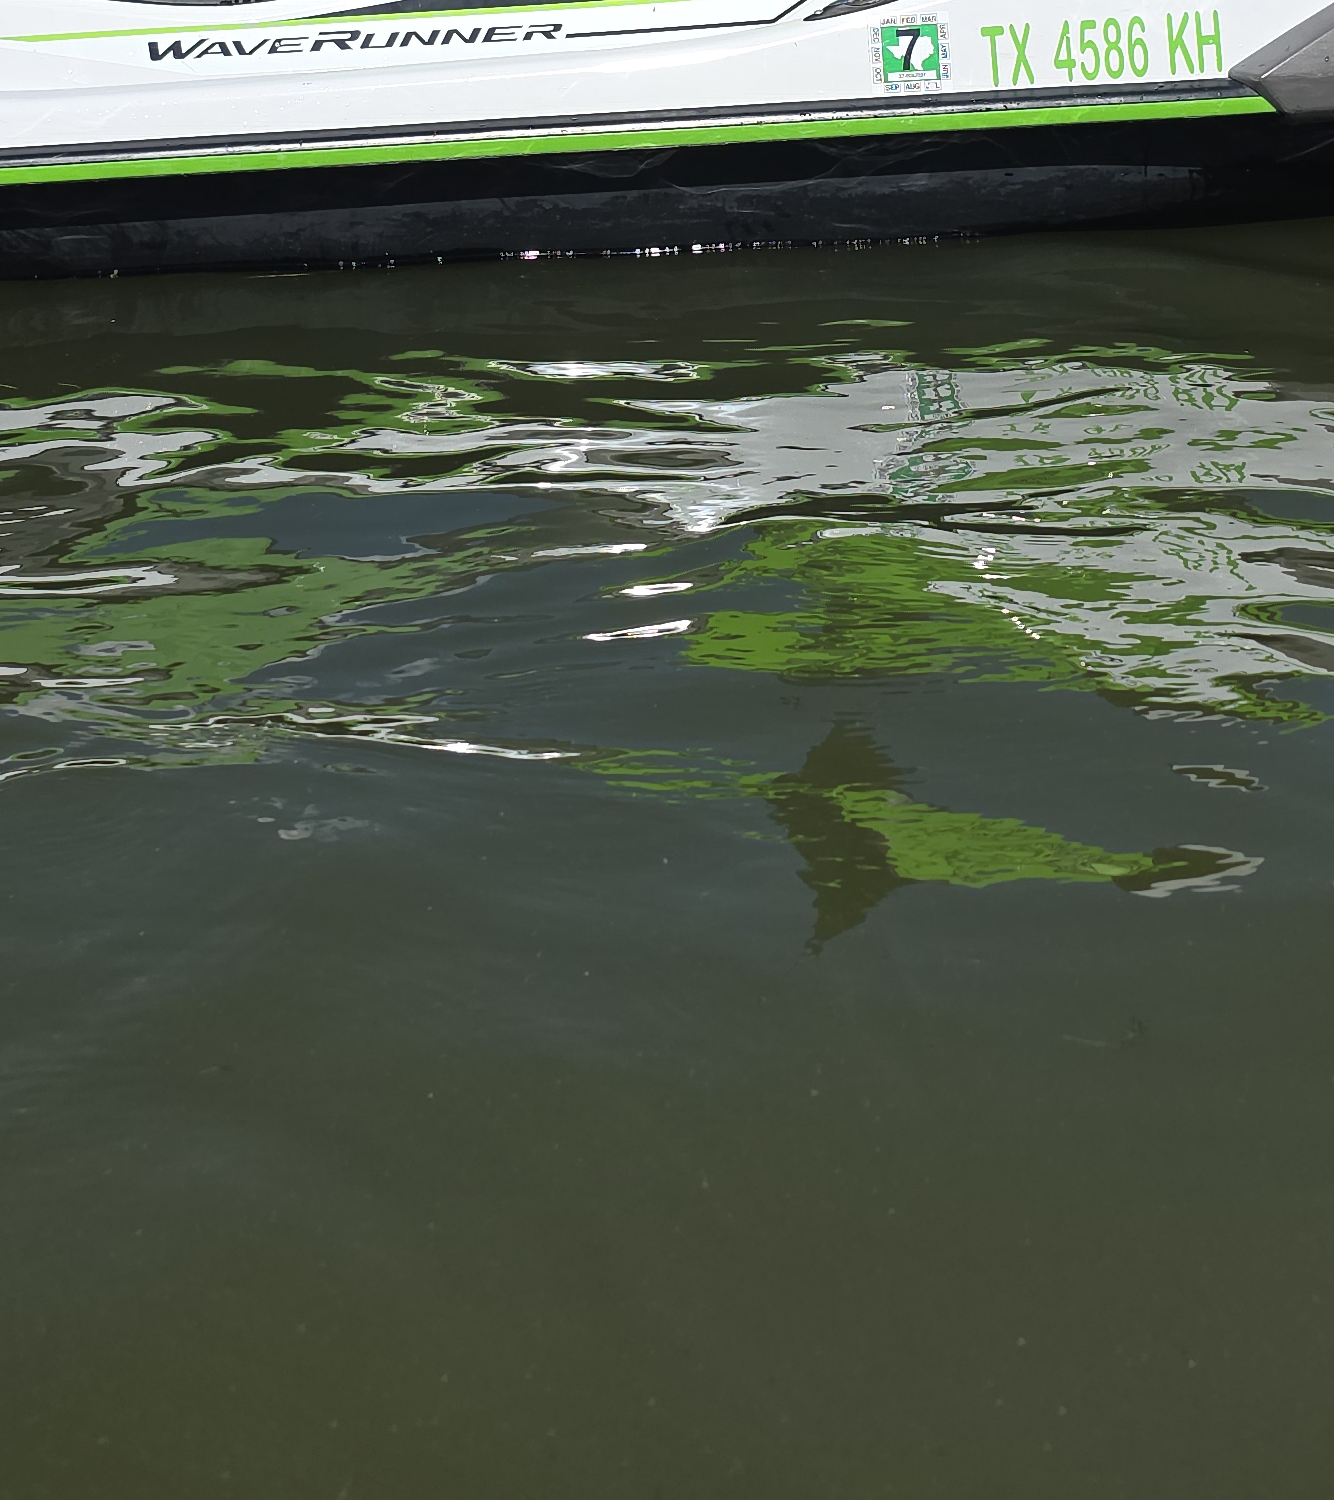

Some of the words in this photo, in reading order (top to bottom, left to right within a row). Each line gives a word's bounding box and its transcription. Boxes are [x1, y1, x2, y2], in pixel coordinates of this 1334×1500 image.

[896, 28, 921, 71] 7
[980, 23, 1034, 87] TX
[1054, 16, 1149, 82] 4586
[1167, 9, 1223, 75] KH
